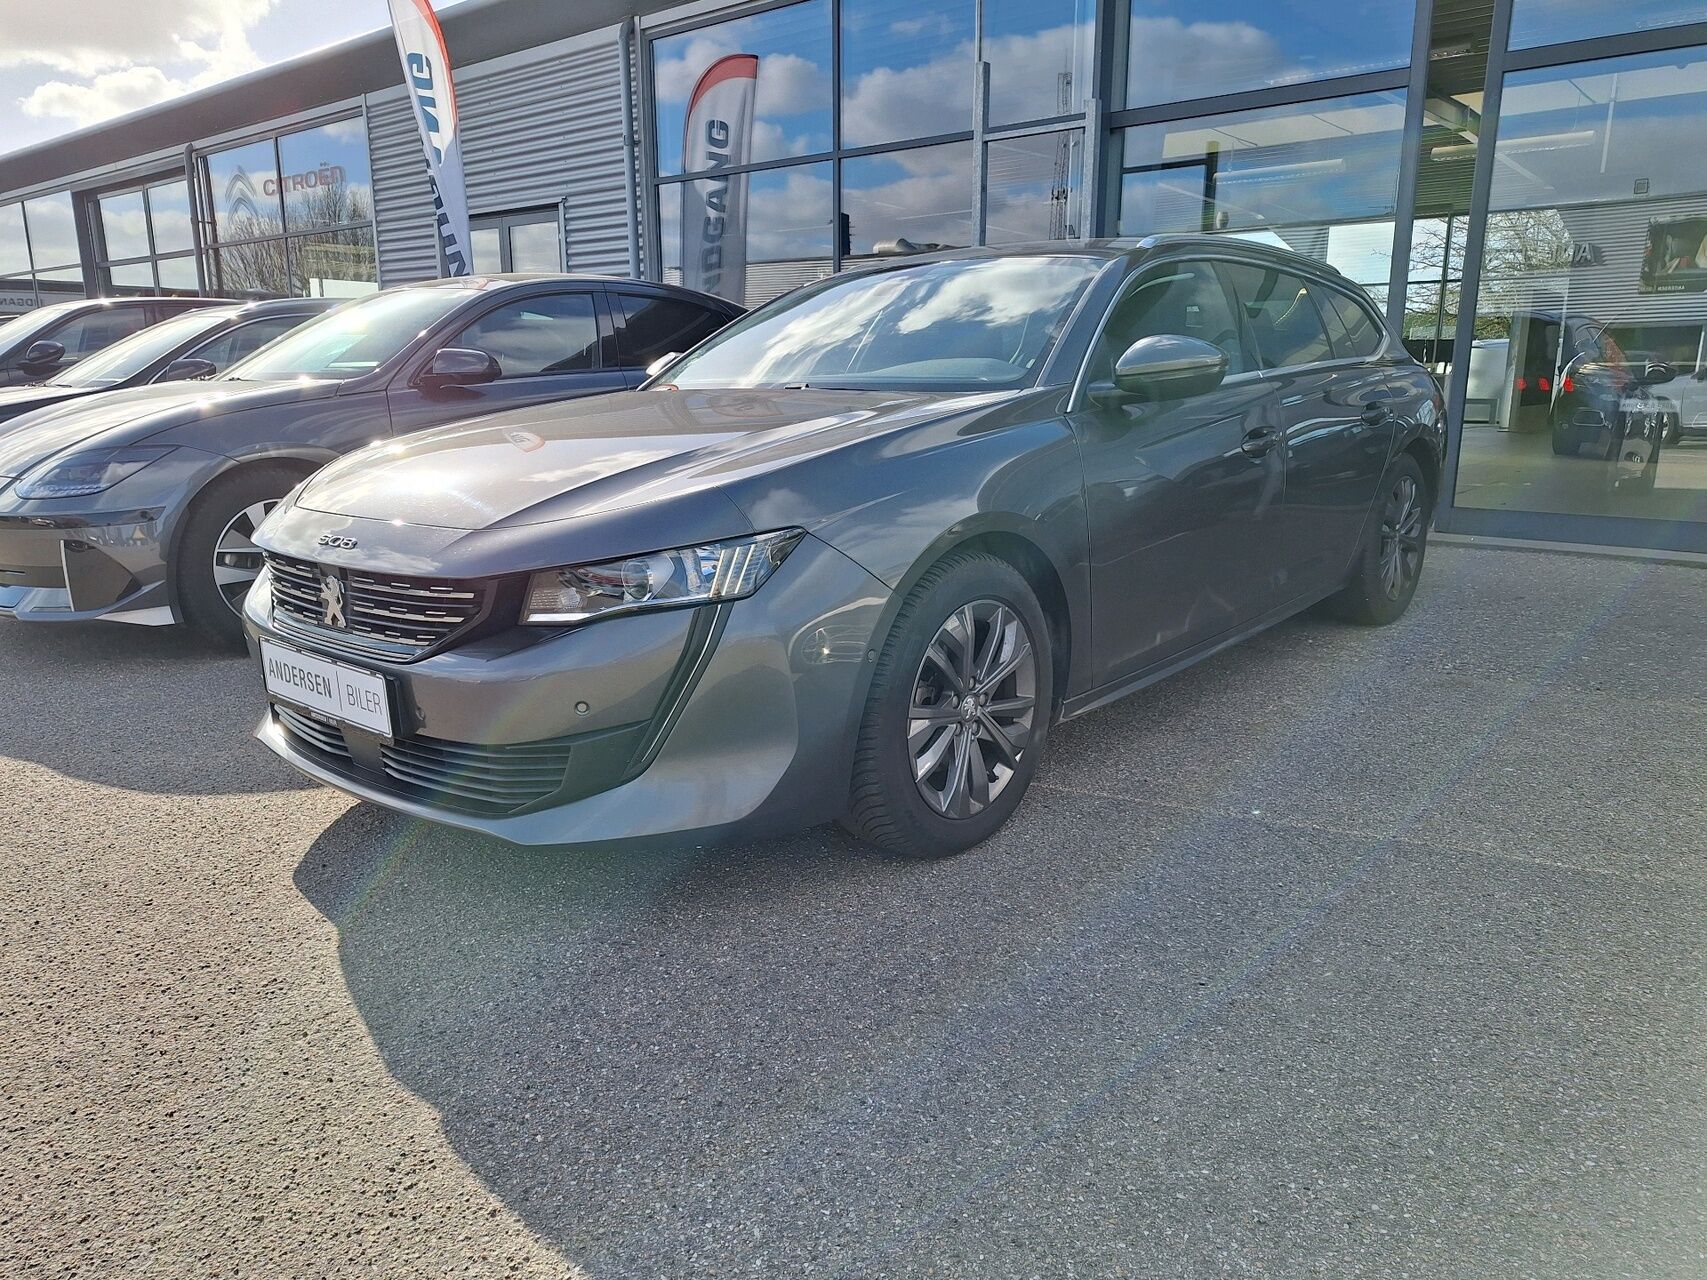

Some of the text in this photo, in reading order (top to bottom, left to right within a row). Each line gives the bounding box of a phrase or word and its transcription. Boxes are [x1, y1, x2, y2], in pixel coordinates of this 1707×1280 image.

[317, 534, 358, 550] 508
[268, 657, 382, 716] ANDERSEN BILER
